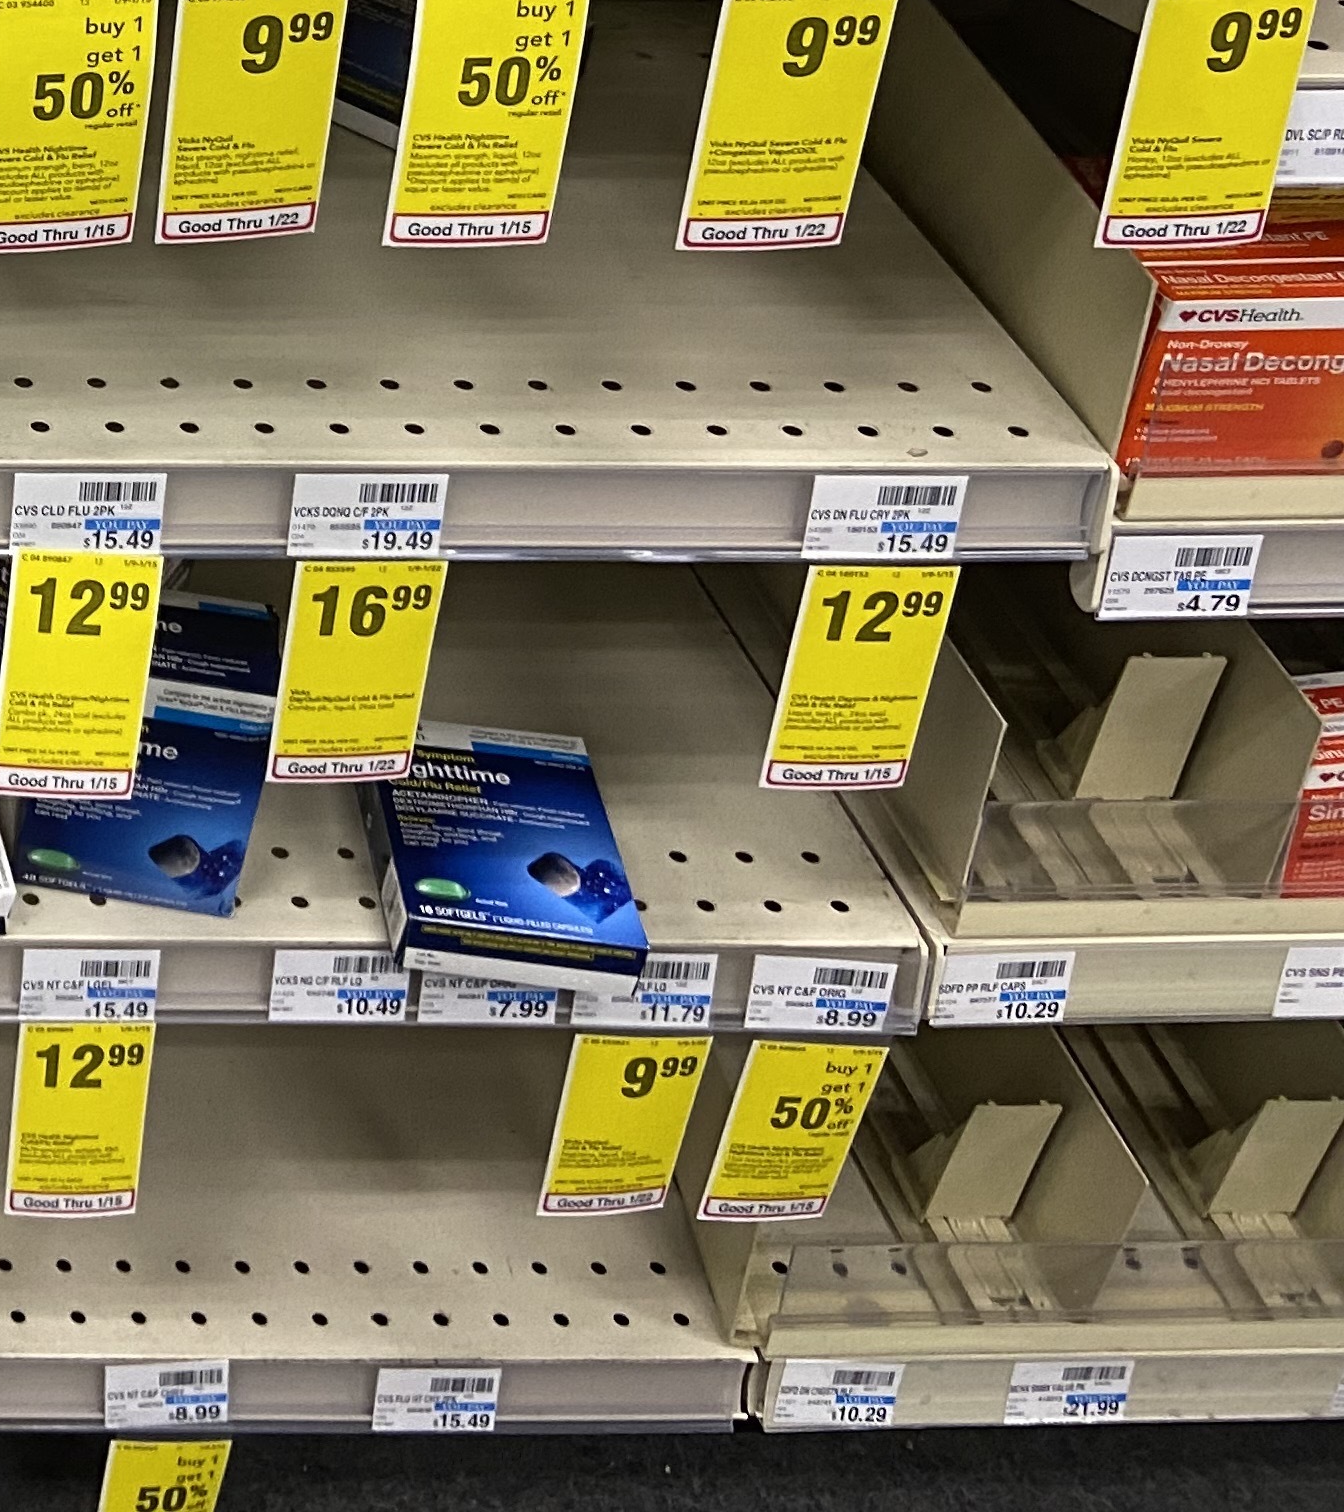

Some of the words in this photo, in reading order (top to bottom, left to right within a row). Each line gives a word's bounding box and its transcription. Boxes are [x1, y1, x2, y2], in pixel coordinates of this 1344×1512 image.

[458, 56, 561, 107] 50%
[1167, 340, 1248, 350] Non-Drowsy
[1159, 352, 1240, 373] Nasal
[84, 526, 159, 549] $15.49
[878, 532, 950, 552] $15.49
[1177, 594, 1240, 611] $4.79
[412, 764, 511, 785] ghttime
[86, 1000, 157, 1021] $15.49
[487, 995, 553, 1018] $7.99
[997, 998, 1062, 1019] $10.29
[1060, 1394, 1125, 1416] $21.99
